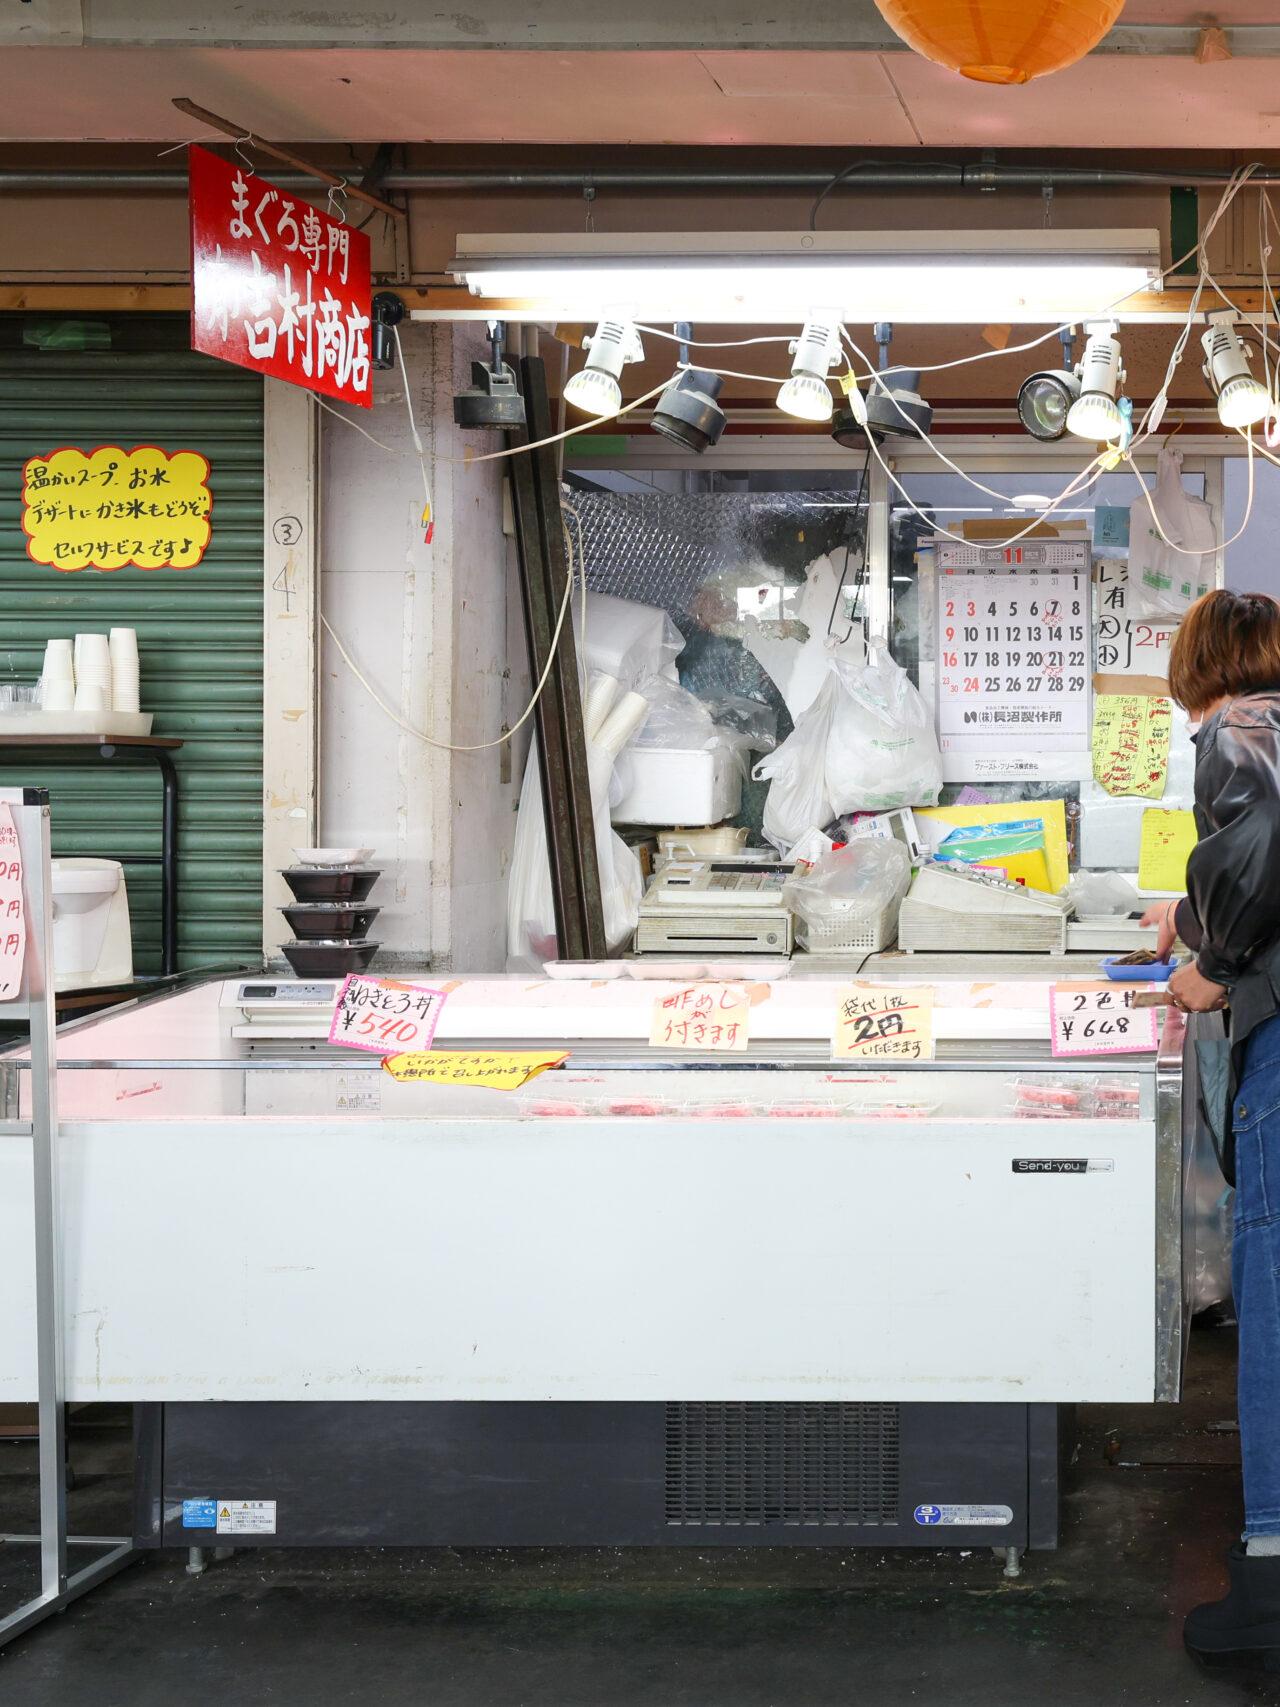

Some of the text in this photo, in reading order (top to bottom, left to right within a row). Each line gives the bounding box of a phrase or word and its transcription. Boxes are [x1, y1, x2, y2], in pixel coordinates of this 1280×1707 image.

[230, 170, 350, 285] まぐろ専門
[1004, 548, 1022, 563] 11
[1073, 576, 1079, 590] 1
[1104, 586, 1125, 610] 有
[946, 601, 1080, 616] 2 3 4 5 6 7 8
[946, 627, 1083, 641] 9 10 11 12 13 14 15
[943, 652, 1085, 666] 16 17 18 19 20 21 22
[942, 677, 1085, 692] 23 24 25 26 27 28 29
[951, 685, 959, 693] 30
[665, 1020, 741, 1049] 付きます
[853, 1013, 904, 1043] 2円
[862, 1040, 922, 1058] いただきます
[1018, 1161, 1080, 1172] Send-you
